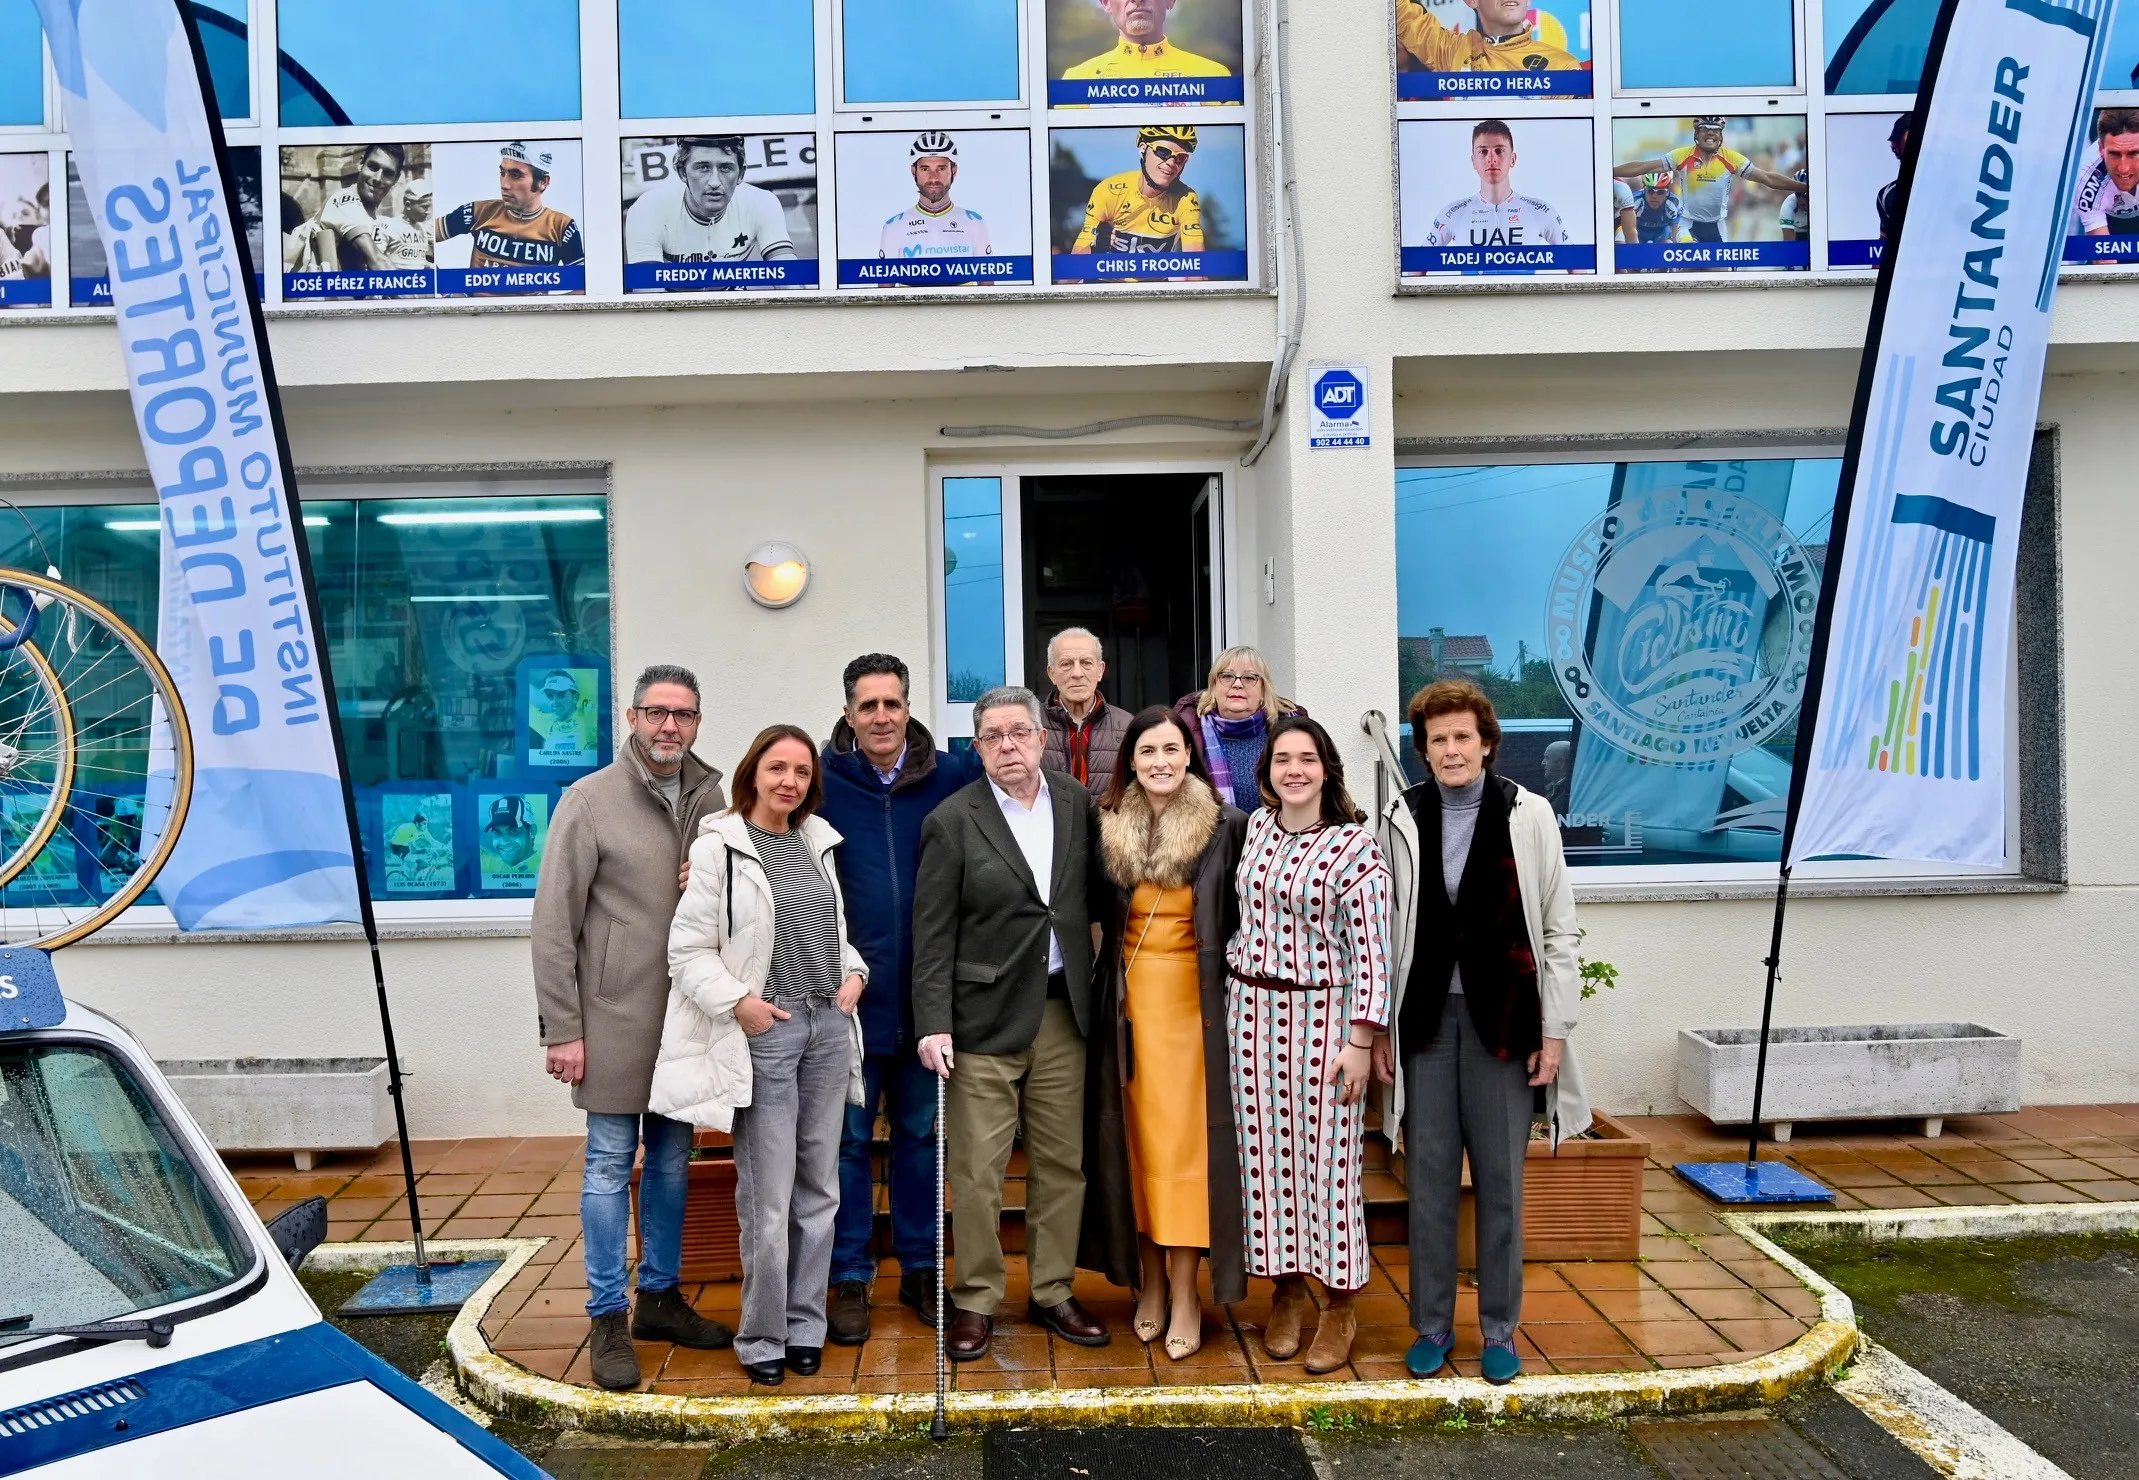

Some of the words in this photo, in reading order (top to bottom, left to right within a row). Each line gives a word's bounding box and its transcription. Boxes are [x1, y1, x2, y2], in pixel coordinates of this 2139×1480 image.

[1087, 85, 1140, 98] MARCO
[1145, 83, 1205, 97] PANTANI
[1438, 77, 1502, 91] ROBERTO
[1507, 77, 1551, 90] HERAS
[1109, 182, 1128, 190] LCL
[2078, 176, 2101, 213] PDM
[1470, 226, 1524, 246] UAE
[476, 230, 554, 262] MOLTENI
[925, 244, 971, 254] movistar
[2095, 241, 2132, 254] SEAN
[1440, 253, 1480, 265] TADEJ
[1486, 252, 1554, 265] POGACAR
[1663, 249, 1711, 262] OSCAR
[1716, 248, 1760, 261] FREIRE
[1929, 56, 2031, 461] SANTANDER
[859, 264, 941, 278] ALEJANDRO
[946, 262, 1013, 276] VALVERDE
[1096, 260, 1137, 272] CHRIS
[1142, 258, 1201, 271] FROOME
[465, 274, 501, 287] EDDY
[505, 272, 561, 286] MERCKS
[655, 269, 708, 282] FREDDY
[712, 266, 786, 281] MAERTENS
[291, 276, 323, 292] JOSÉ
[327, 275, 365, 291] PÉREZ
[369, 273, 427, 289] FRANCÉS
[1323, 386, 1355, 404] ADT
[1969, 324, 2014, 467] CIUDAD
[1320, 420, 1349, 428] Alarma
[1316, 438, 1330, 446] 902
[1332, 438, 1342, 446] 44
[1355, 437, 1364, 445] 40
[1552, 516, 1625, 621] MUSEO
[1653, 679, 1744, 717] Santander
[1585, 701, 1686, 754] SANTIAGO
[1693, 700, 1788, 754] REVUELTA
